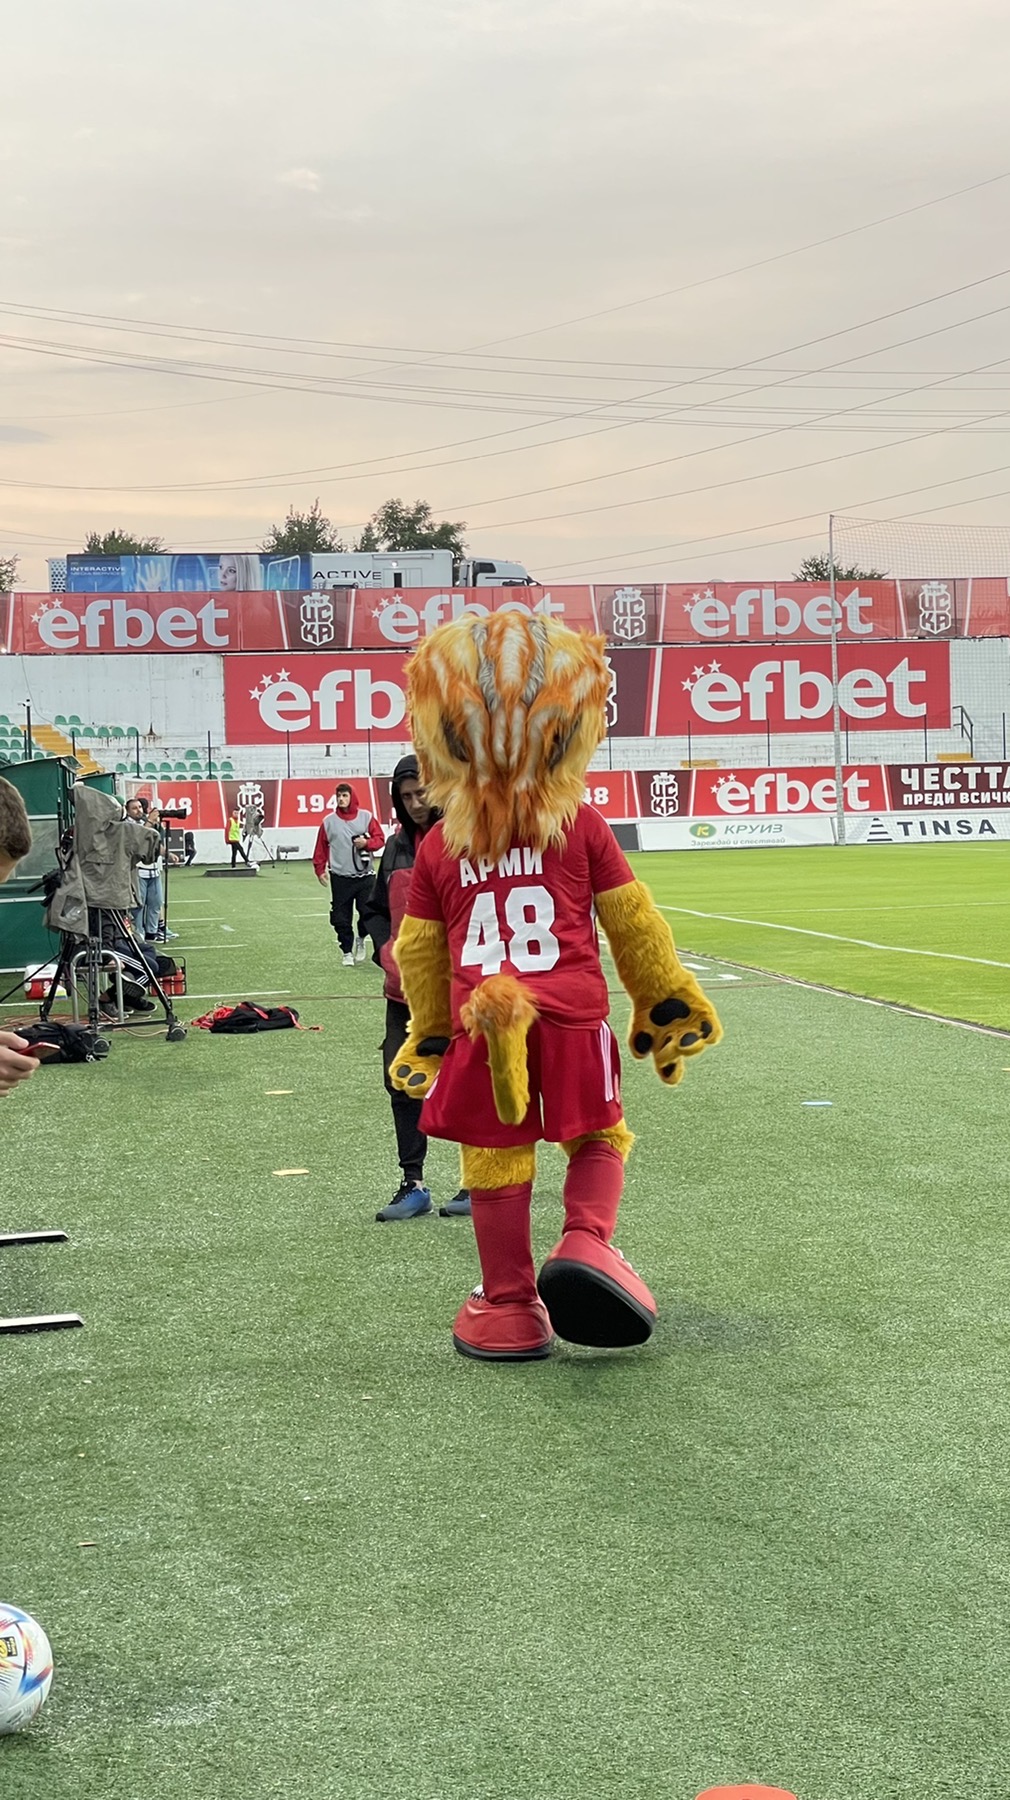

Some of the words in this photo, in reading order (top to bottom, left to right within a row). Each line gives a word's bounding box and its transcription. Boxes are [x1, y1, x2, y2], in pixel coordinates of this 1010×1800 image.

[313, 570, 381, 580] ACTIVE
[38, 598, 229, 648] efbet
[690, 587, 873, 637] efbet
[691, 657, 926, 722] efbet
[716, 771, 870, 814] efbet
[903, 792, 955, 806] ПРЕДИ
[724, 824, 783, 834] КРУИЗ
[897, 819, 997, 836] TINSA
[460, 847, 543, 888] АРМИ
[461, 885, 560, 976] 48
